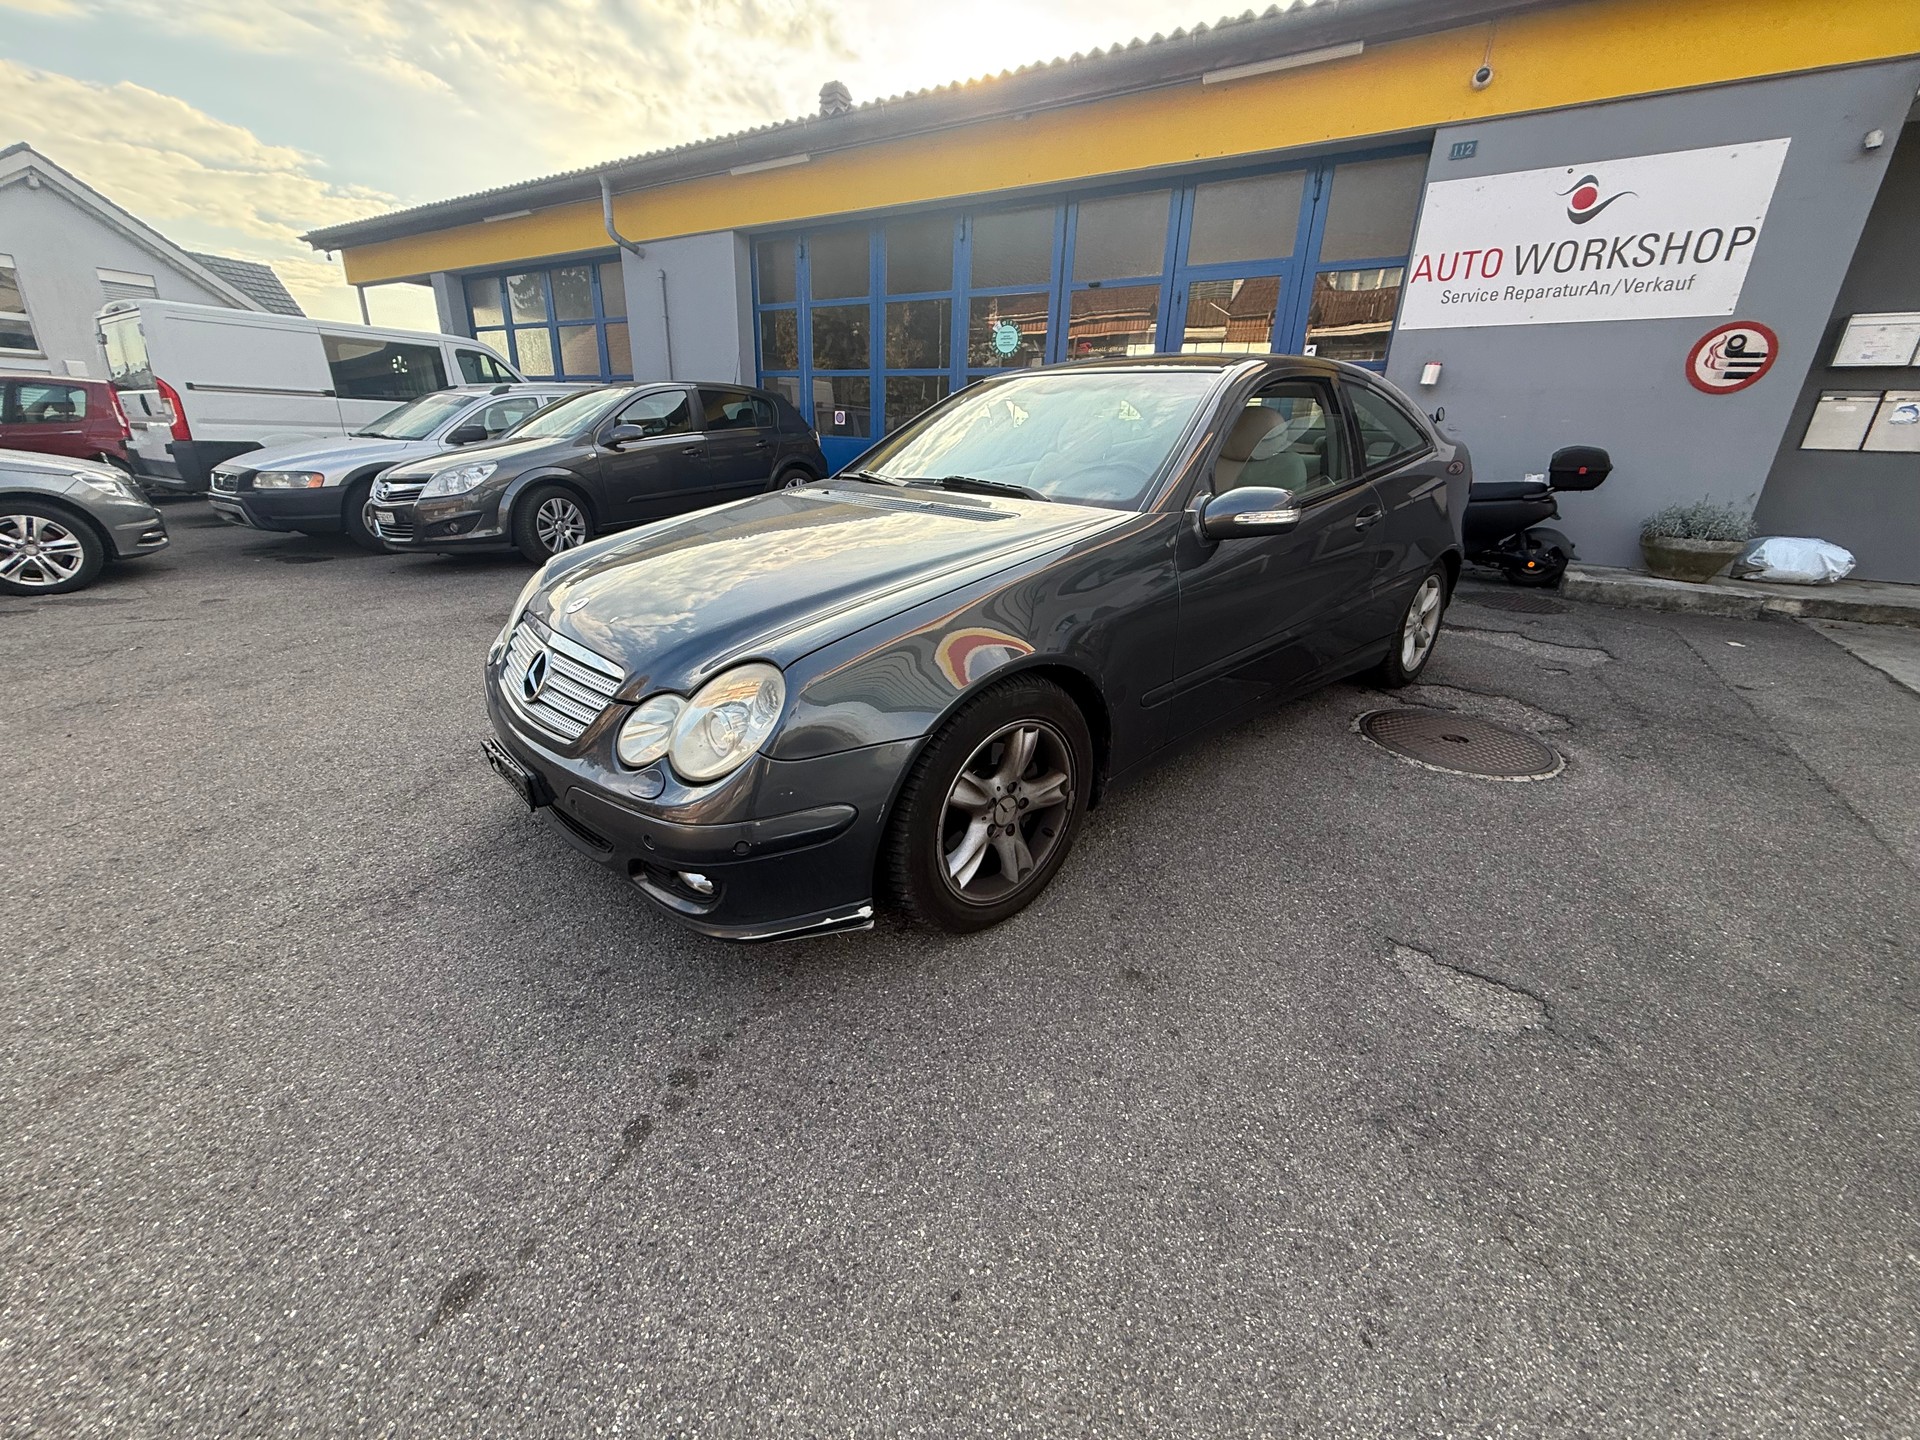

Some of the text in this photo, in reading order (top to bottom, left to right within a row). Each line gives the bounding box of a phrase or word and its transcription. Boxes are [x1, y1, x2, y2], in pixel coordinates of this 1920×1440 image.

[1453, 143, 1474, 157] 112
[1410, 225, 1757, 284] AUTO WORKSHOP
[1440, 287, 1499, 304] Service
